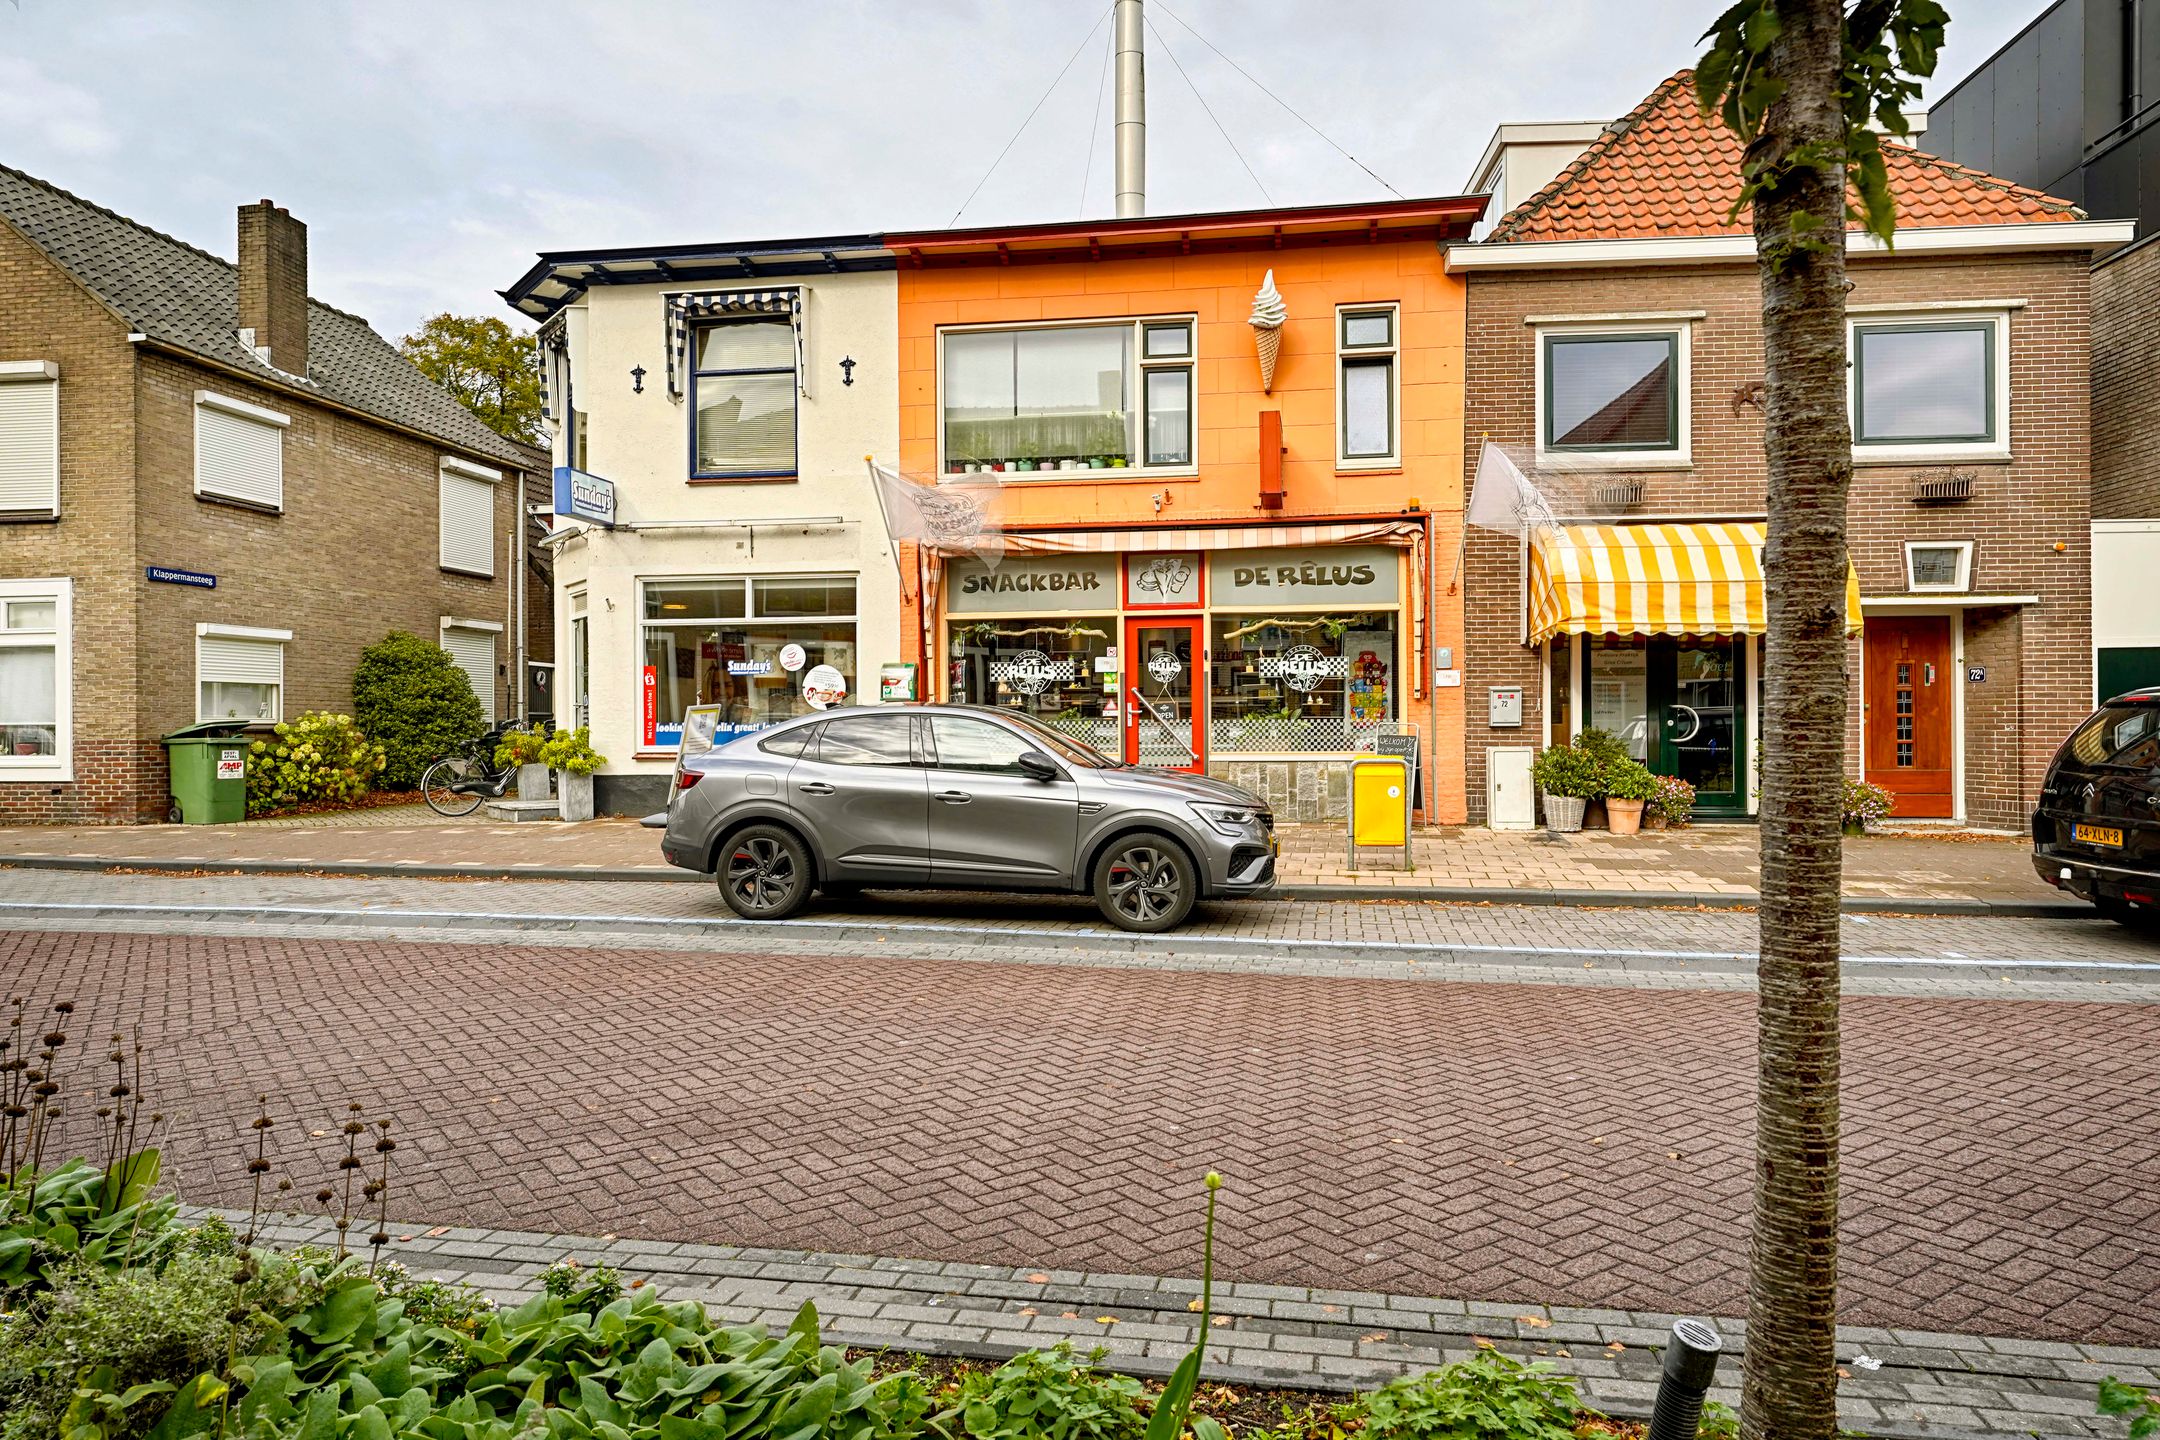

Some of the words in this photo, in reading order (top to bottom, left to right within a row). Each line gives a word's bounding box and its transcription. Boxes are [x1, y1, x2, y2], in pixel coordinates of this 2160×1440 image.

[573, 481, 612, 514] Sunday's
[153, 569, 213, 586] Klappermansteeg
[1233, 566, 1271, 587] DE
[1277, 560, 1375, 587] RÊLUS
[962, 571, 1101, 594] SNACKBAR
[728, 659, 771, 674] Sunday's
[1501, 700, 1508, 708] 72
[716, 722, 734, 732] elin'
[734, 722, 759, 733] great!
[220, 762, 242, 770] AMP
[2078, 826, 2119, 843] 64-XLN-8
